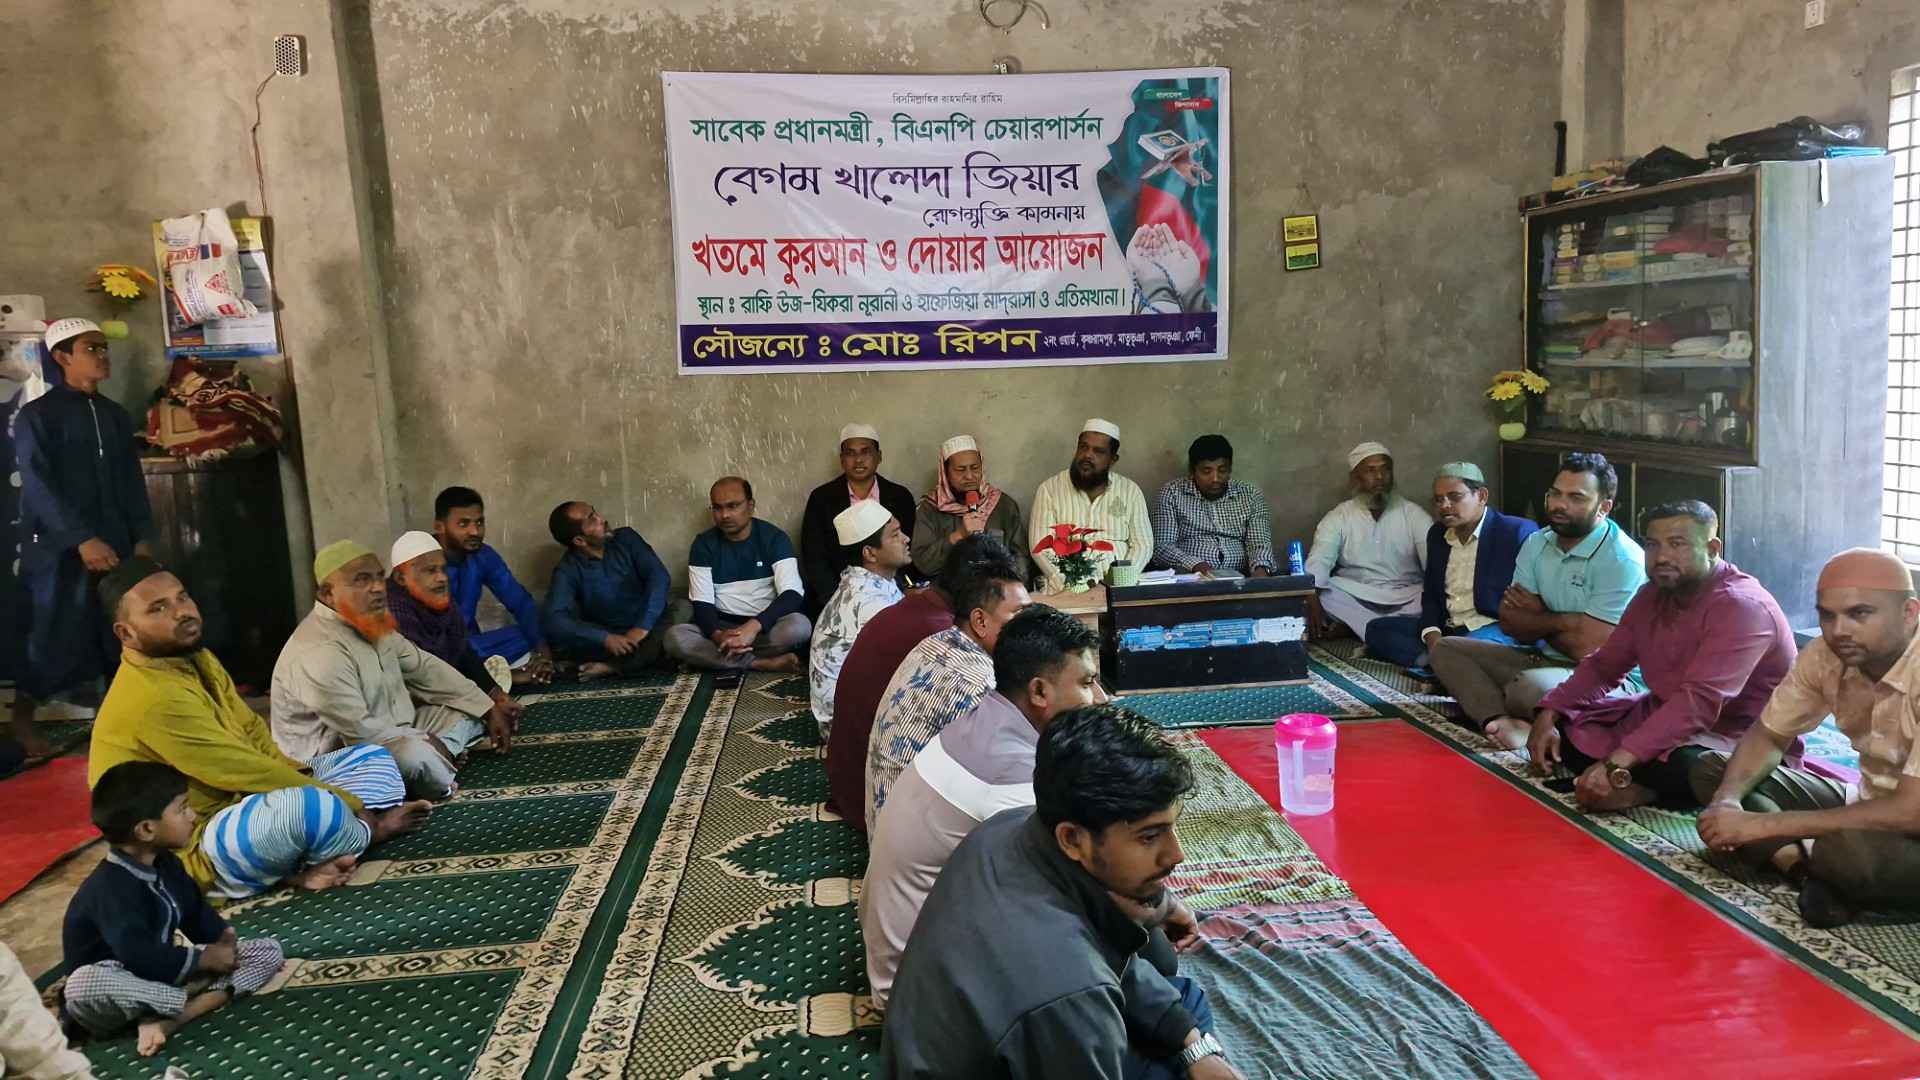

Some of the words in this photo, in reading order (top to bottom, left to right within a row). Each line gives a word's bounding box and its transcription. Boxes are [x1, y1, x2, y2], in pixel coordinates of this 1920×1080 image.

[690, 118, 767, 143] সাবেক
[891, 112, 976, 143] বিএনপি
[984, 108, 1104, 142] চেয়ারপার্সন
[714, 162, 822, 205] বেগম
[835, 164, 952, 205] খালেদা
[962, 150, 1081, 196] জিয়ার
[923, 201, 1010, 228] রোগমুক্তি
[1016, 204, 1088, 223] কামনায়
[691, 233, 768, 277] খতমে
[774, 235, 868, 289] কুরআন
[877, 238, 897, 272] ও
[907, 232, 987, 275] দোয়ার
[995, 230, 1107, 273] আয়োজন
[697, 296, 724, 320] স্থান
[740, 289, 773, 315] রাফি
[858, 287, 900, 317] নূরানী
[902, 293, 914, 311] ও
[917, 286, 979, 313] হাফেজিয়া
[1039, 290, 1050, 309] ও
[693, 326, 808, 359] সৌজন্যে
[842, 331, 920, 357] মোঃ
[934, 323, 1041, 353] রিপন
